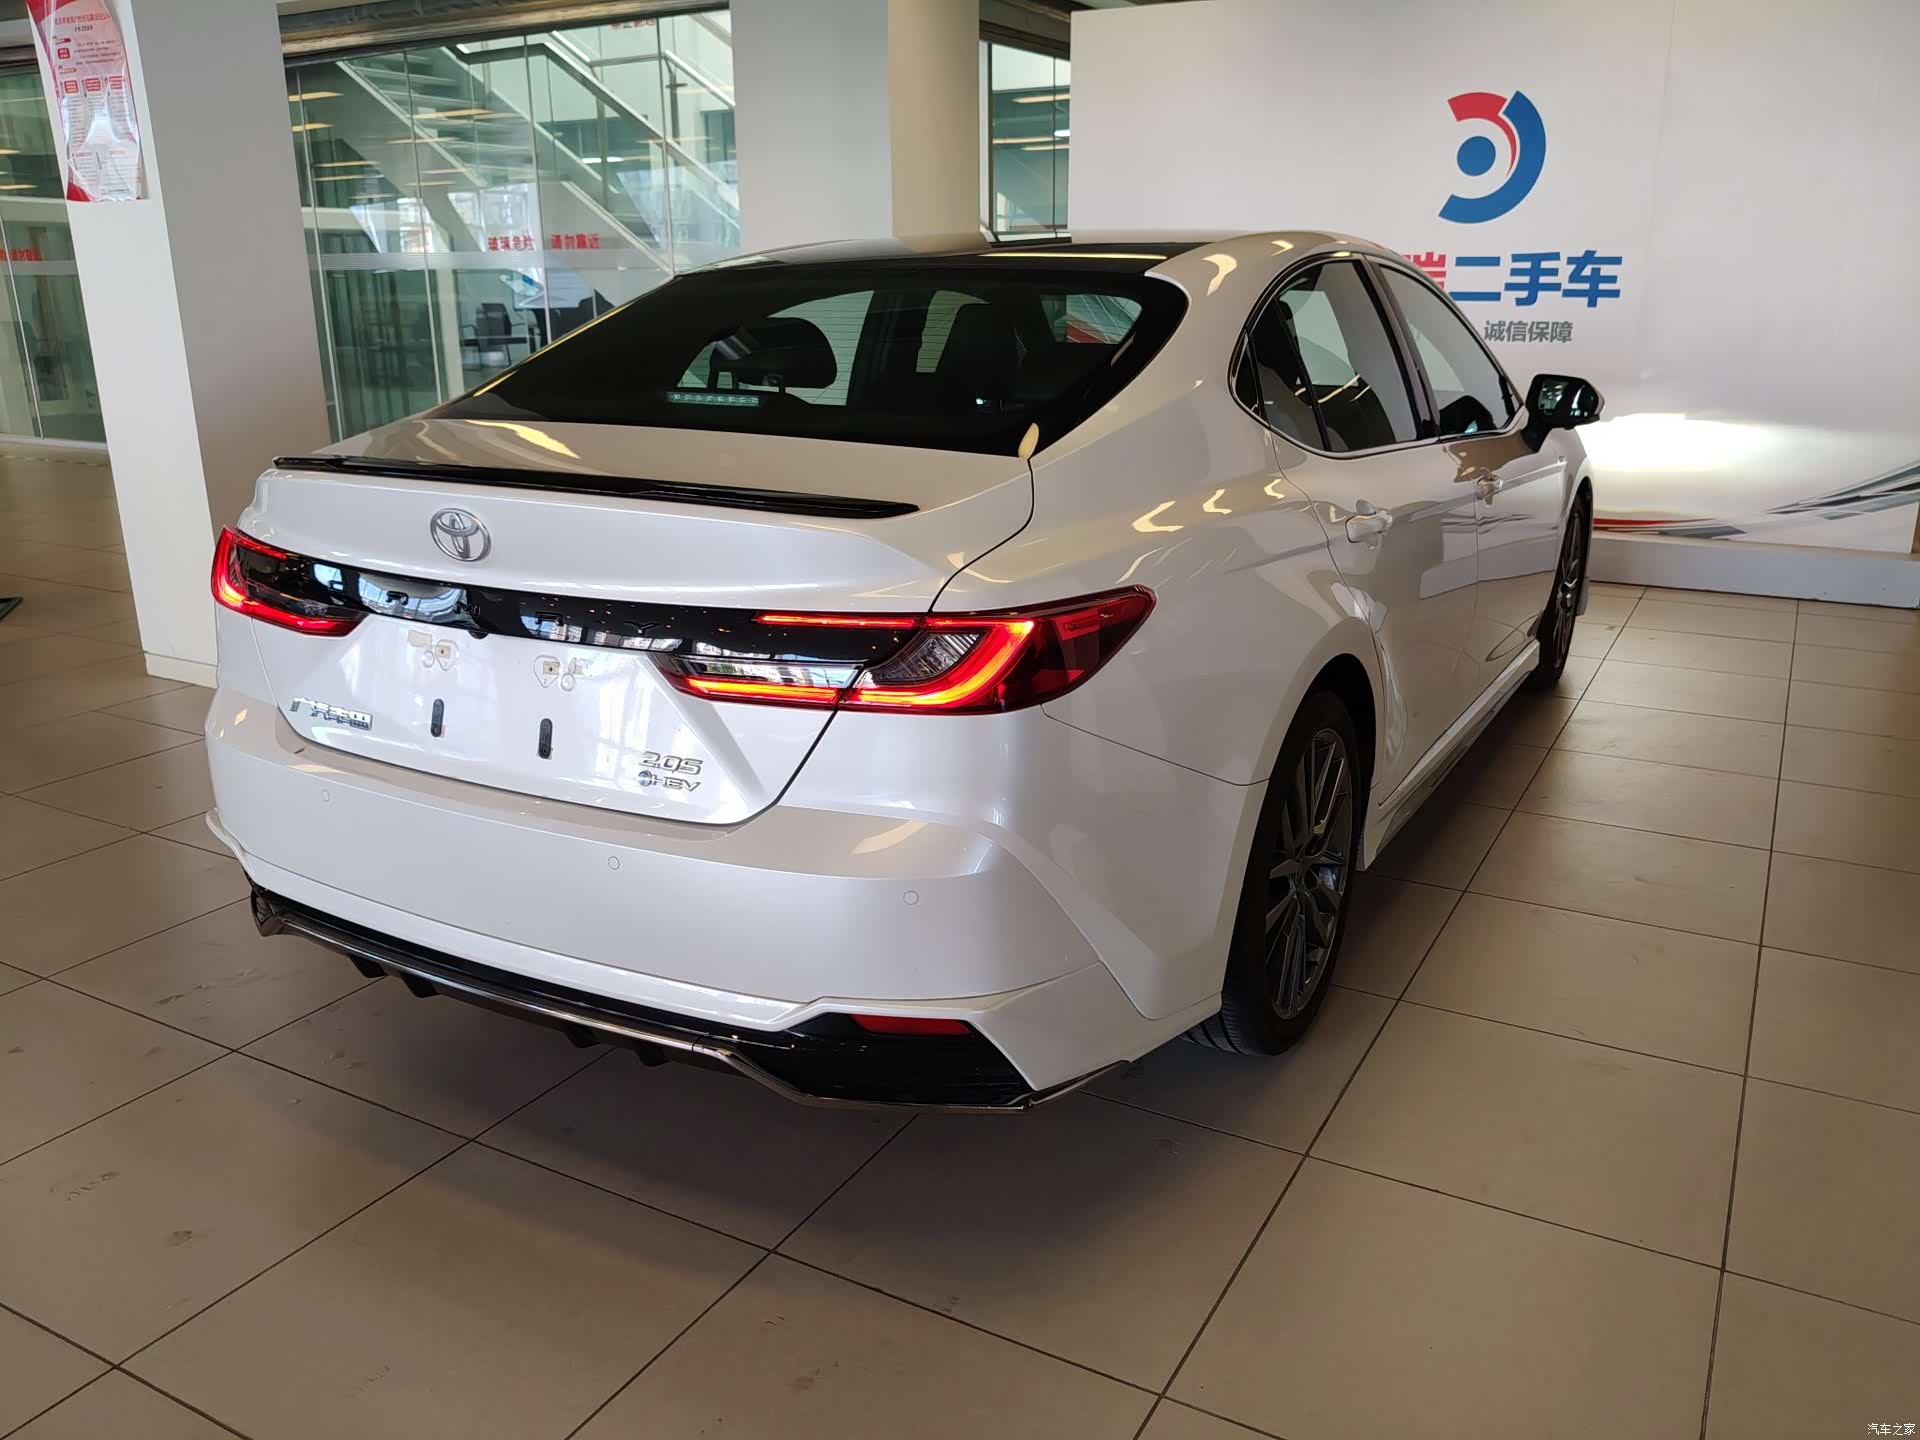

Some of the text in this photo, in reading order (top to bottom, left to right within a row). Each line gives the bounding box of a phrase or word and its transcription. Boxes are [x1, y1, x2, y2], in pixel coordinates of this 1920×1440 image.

[1483, 320, 1573, 344] 诚信保障
[639, 750, 703, 776] 2.0S
[651, 773, 702, 793] HEV
